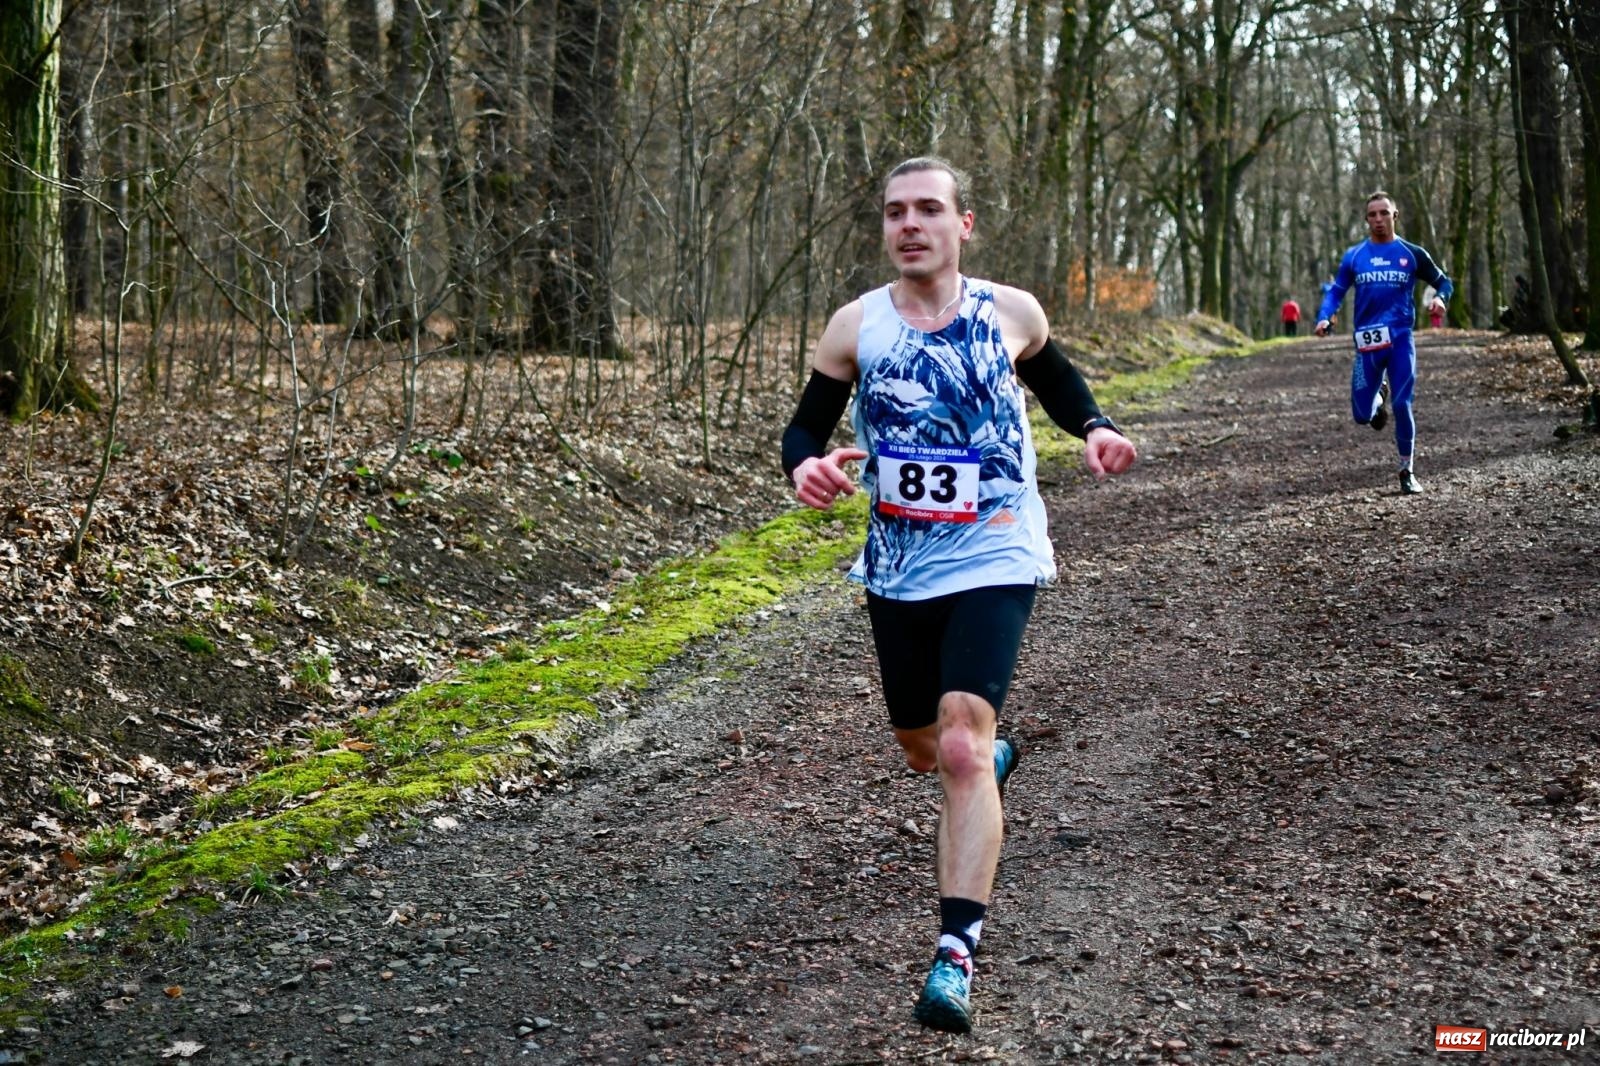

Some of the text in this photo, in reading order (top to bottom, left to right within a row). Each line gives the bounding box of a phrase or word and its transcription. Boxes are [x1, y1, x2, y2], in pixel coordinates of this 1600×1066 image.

[1362, 329, 1382, 345] 93
[889, 444, 969, 456] XII BIEG TWARDZIELA
[898, 462, 957, 504] 83
